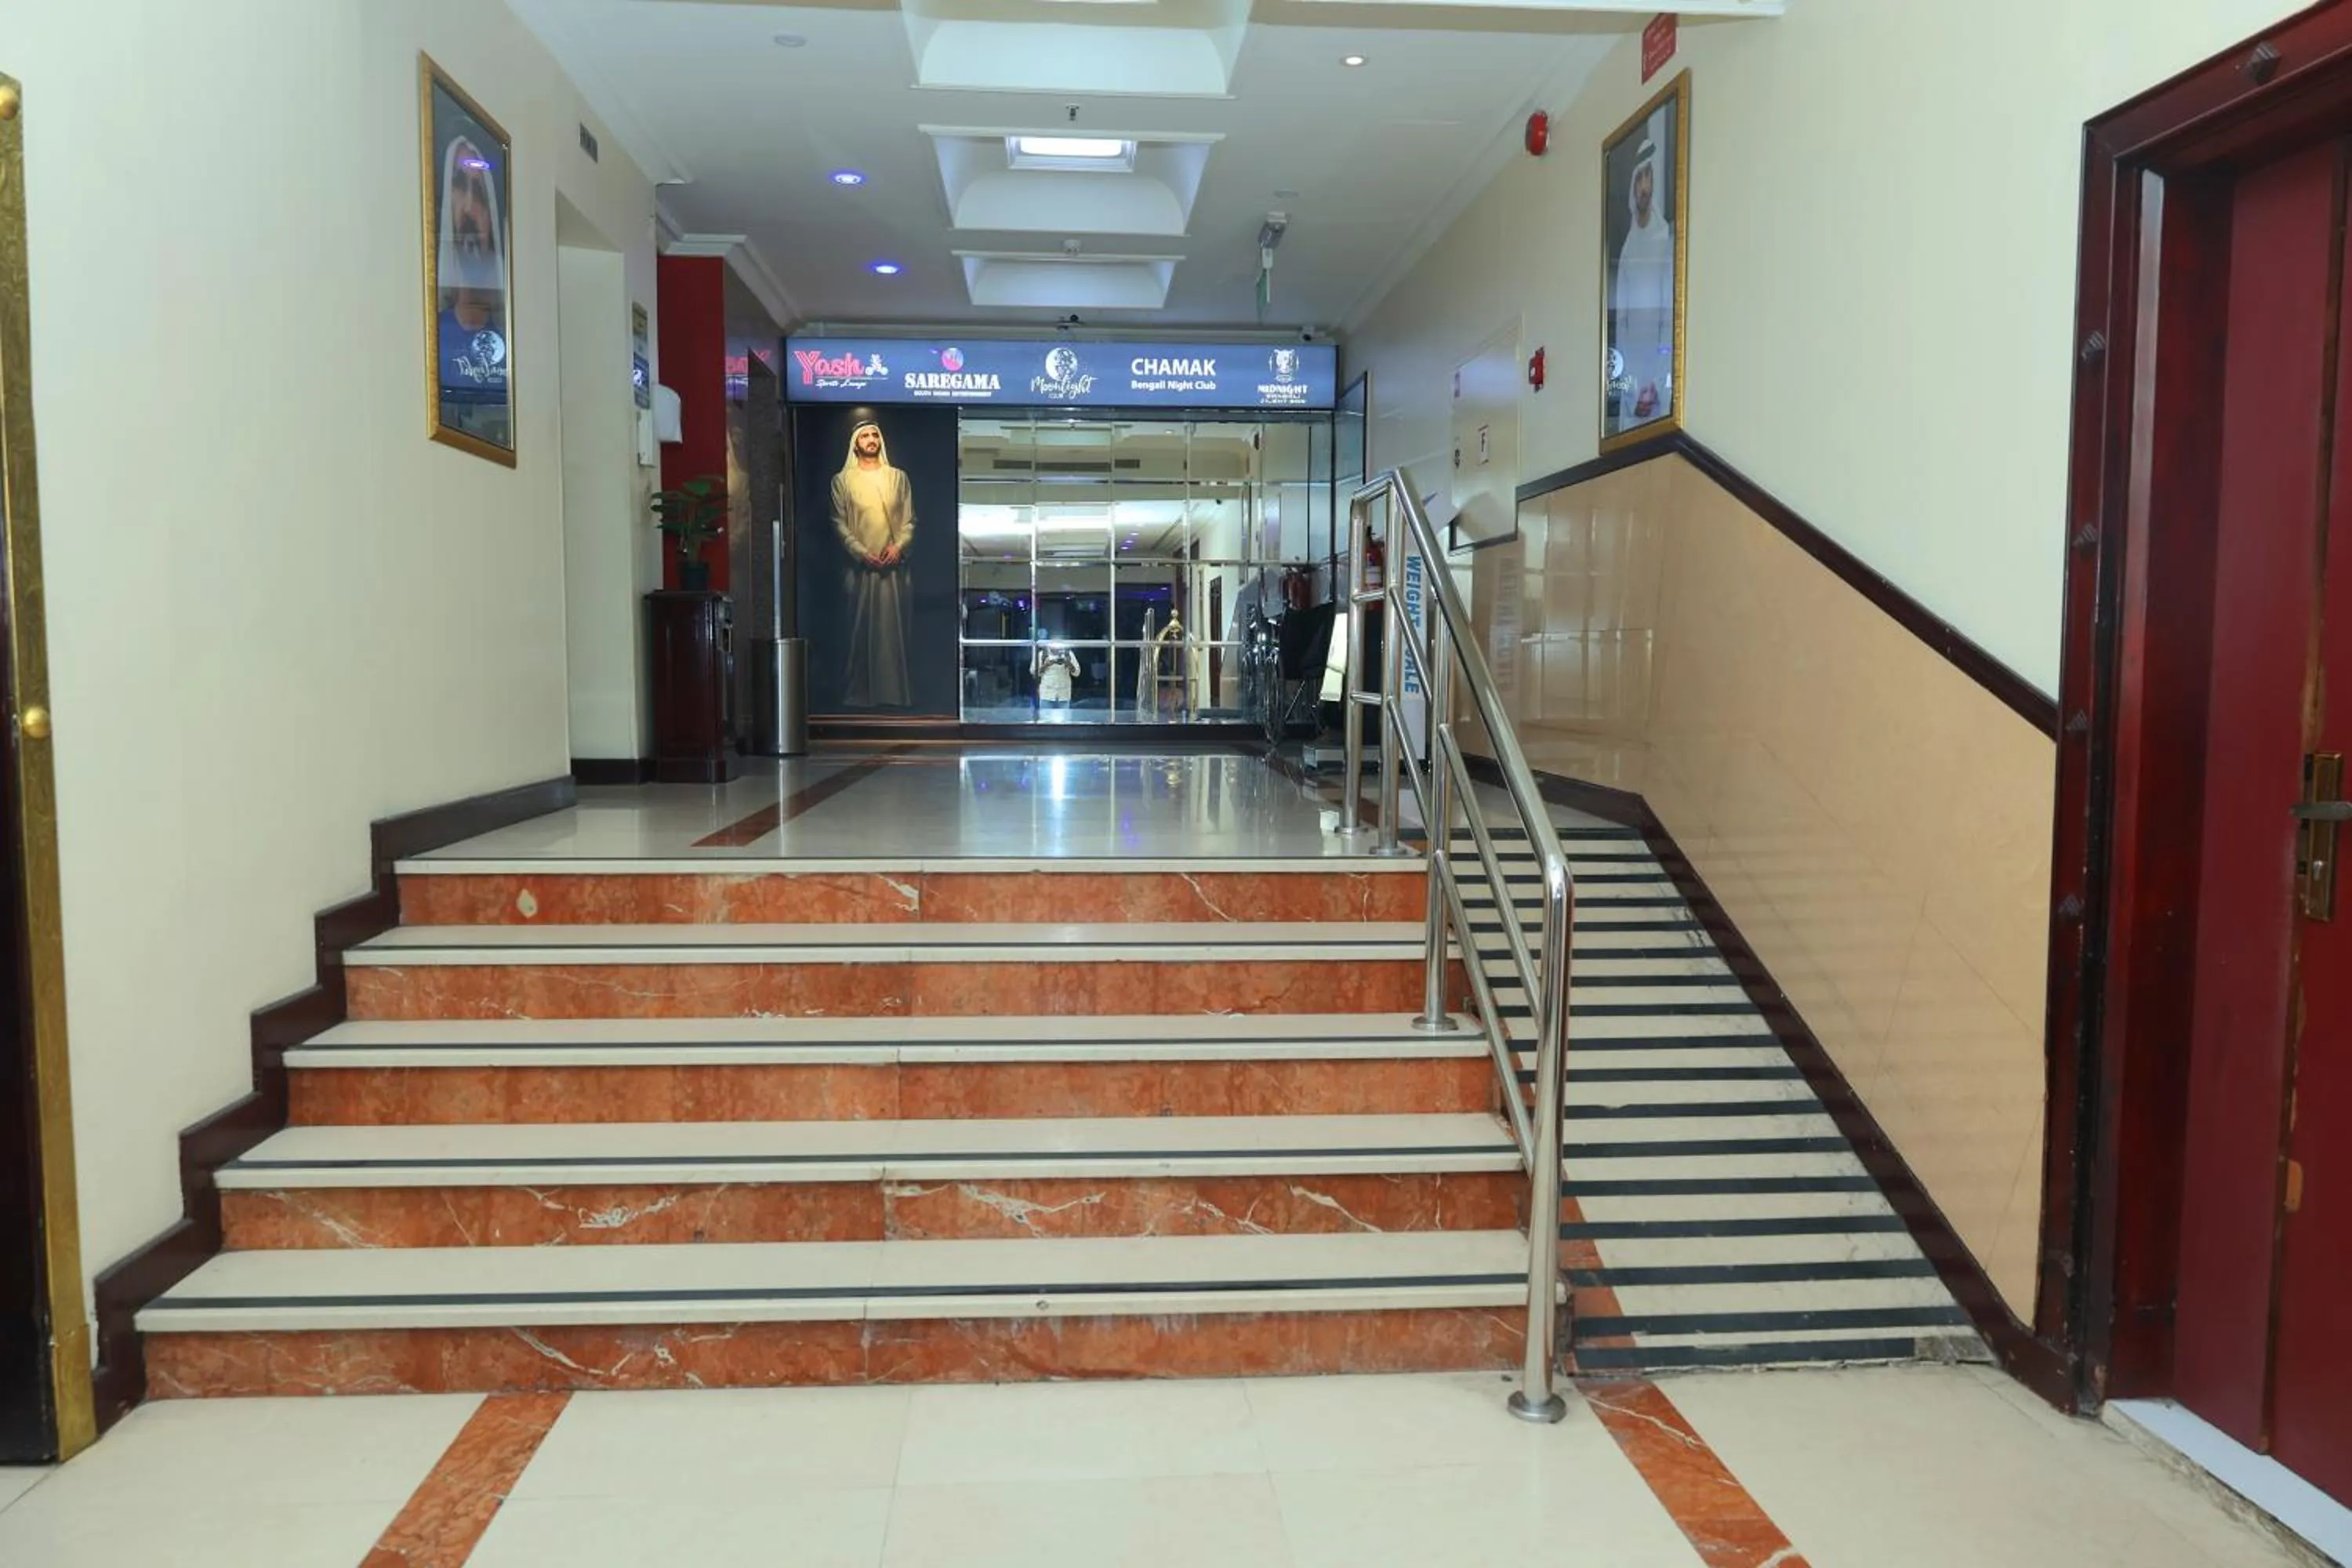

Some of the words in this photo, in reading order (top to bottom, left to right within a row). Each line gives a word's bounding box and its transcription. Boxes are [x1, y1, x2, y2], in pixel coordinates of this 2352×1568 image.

[793, 350, 865, 385] Yash
[1131, 358, 1217, 376] CHAMAK
[904, 372, 1001, 390] SAREGAMA
[1031, 374, 1099, 399] Moonlight
[1131, 380, 1166, 391] Bengali
[1167, 380, 1193, 391] Night
[1195, 380, 1217, 390] Club
[1257, 384, 1308, 394] MIDNIGHT
[1406, 556, 1421, 628] WEIGHT
